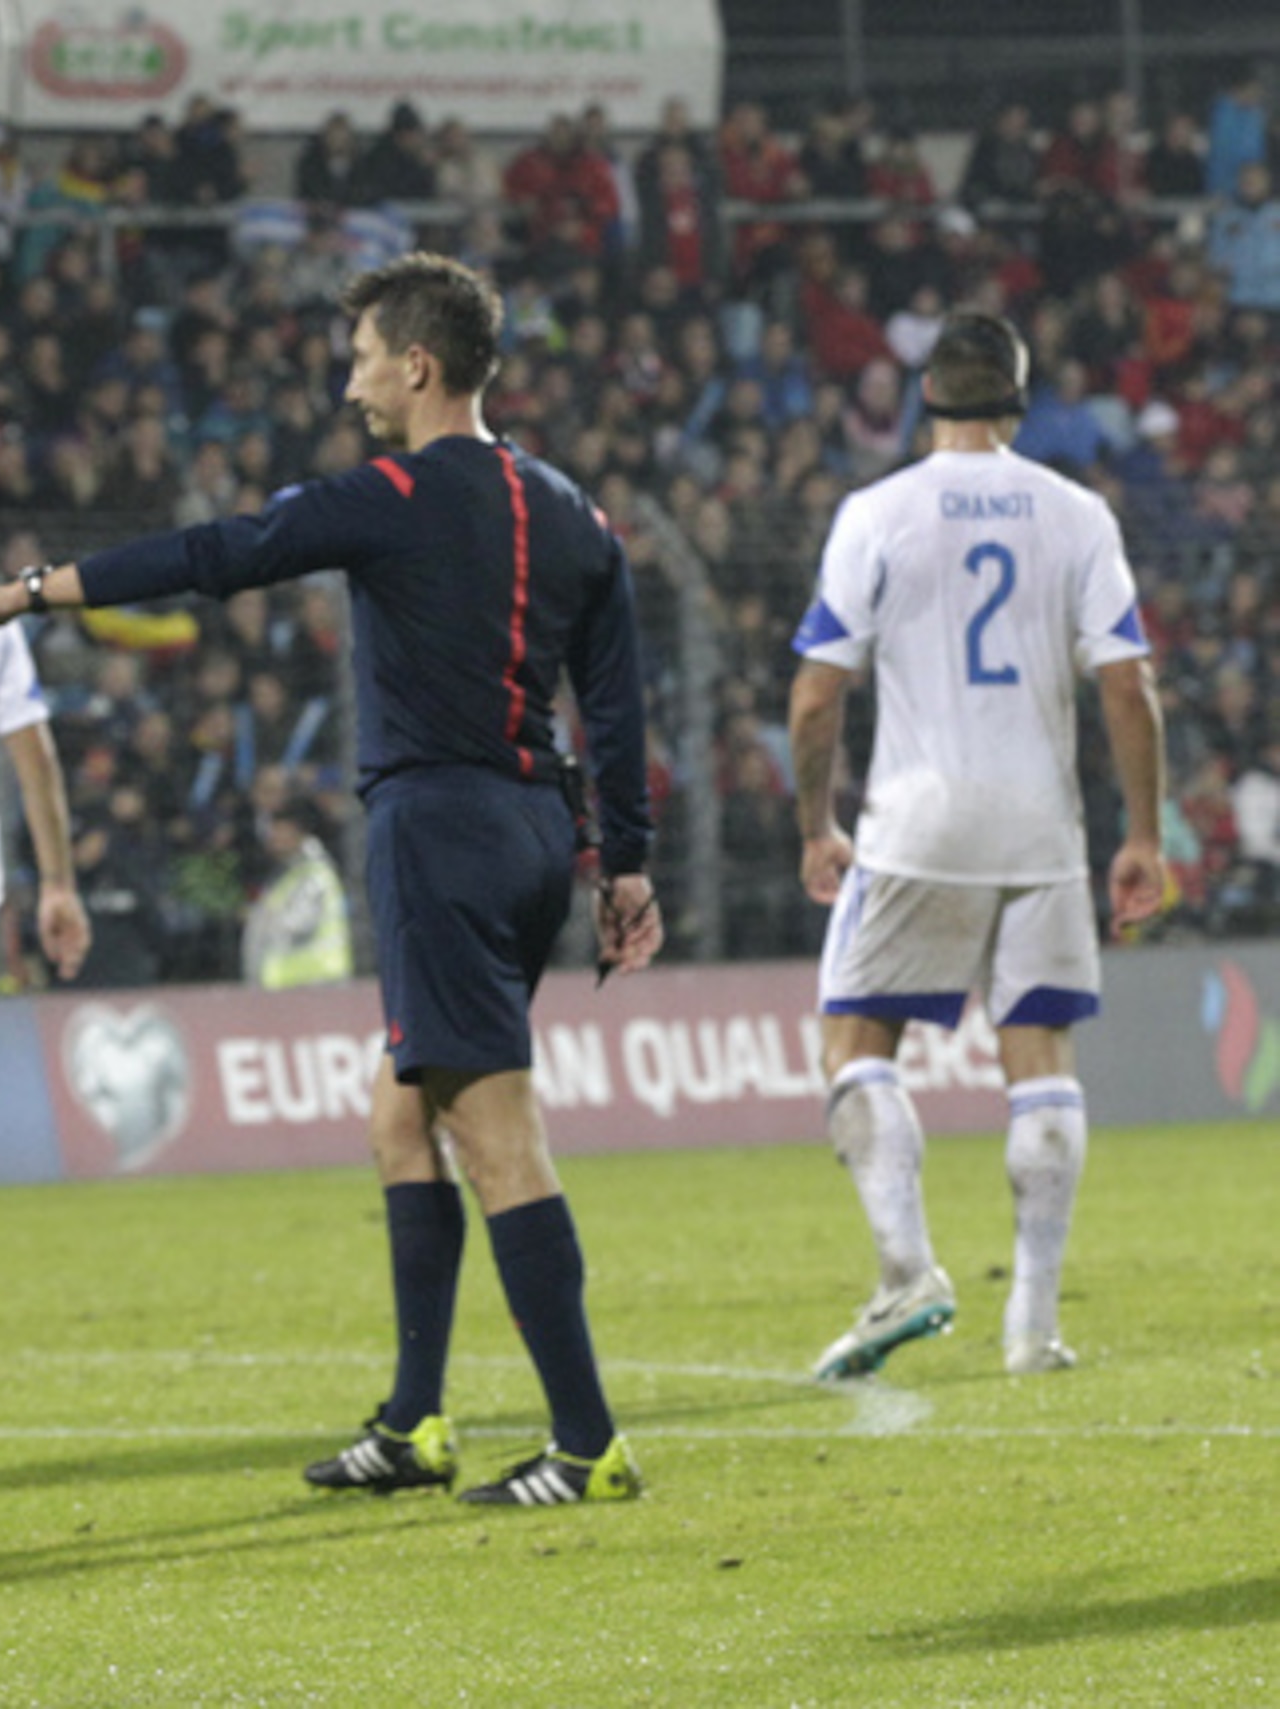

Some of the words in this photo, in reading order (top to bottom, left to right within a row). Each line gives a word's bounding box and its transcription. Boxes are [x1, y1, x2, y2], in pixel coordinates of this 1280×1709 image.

[222, 12, 362, 58] Sport
[381, 12, 644, 54] Construct
[963, 540, 1021, 686] 2
[217, 1022, 611, 1126] EURAN
[622, 998, 1010, 1118] QUALIERS
